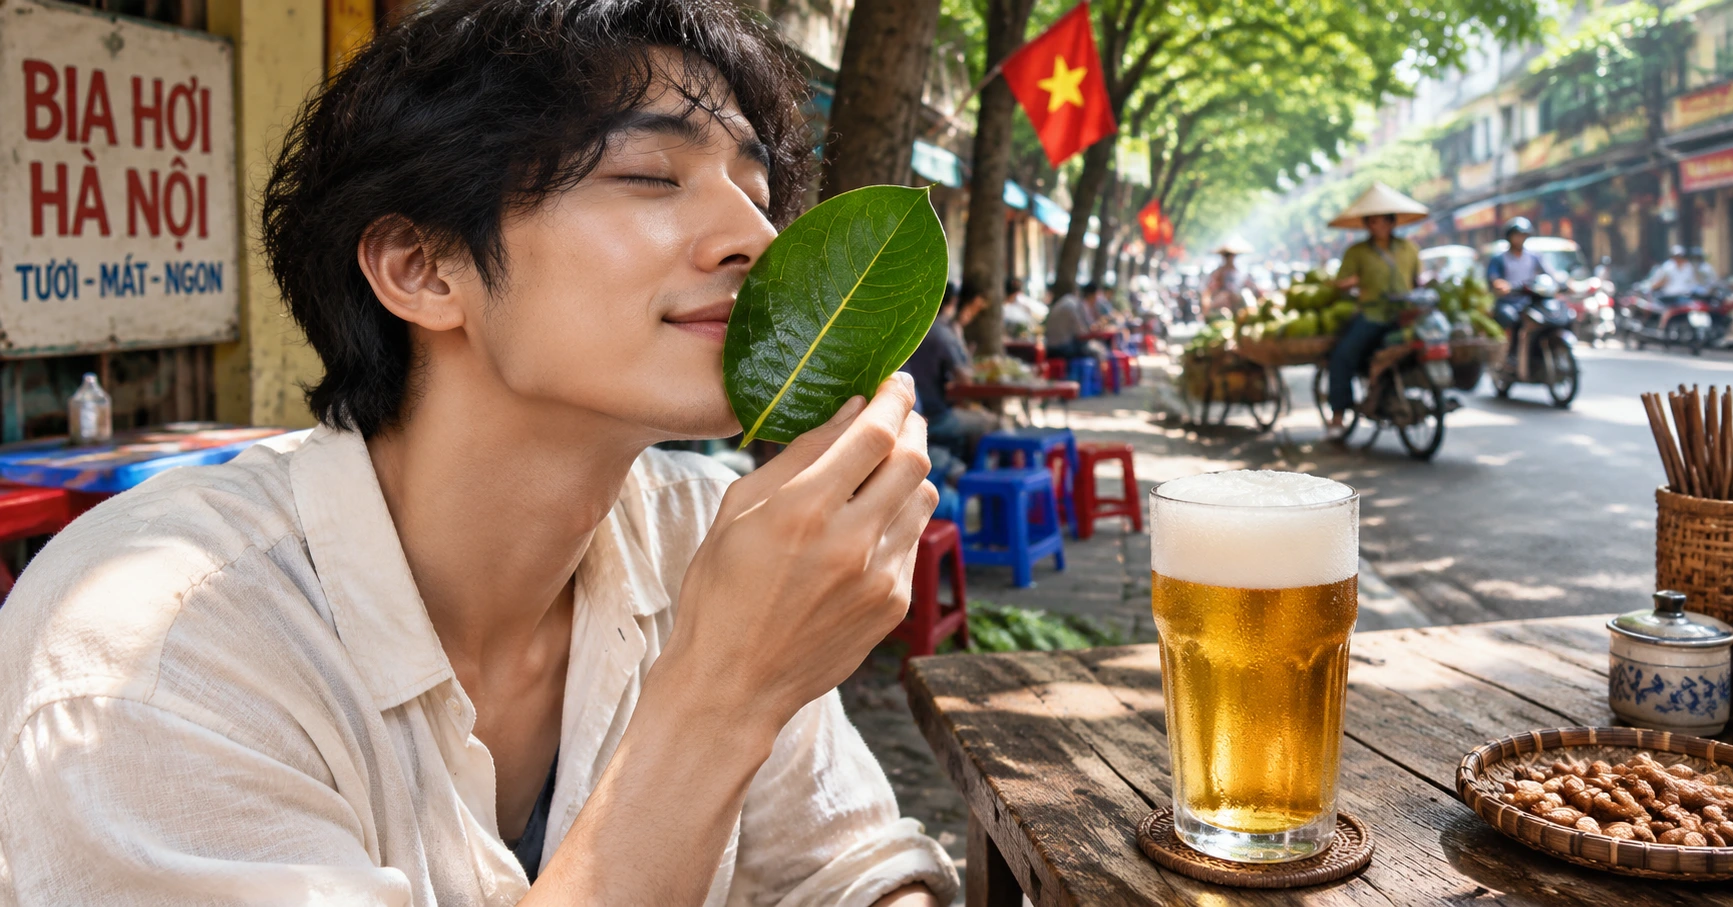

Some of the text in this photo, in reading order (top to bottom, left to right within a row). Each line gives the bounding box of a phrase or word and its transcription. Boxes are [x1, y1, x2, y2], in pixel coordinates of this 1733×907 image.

[22, 59, 211, 154] BIA HƠI
[30, 147, 208, 251] HÀ NỘI
[15, 258, 78, 301] TƯƠI
[100, 253, 147, 296] MÁT
[164, 262, 223, 294] NGON
